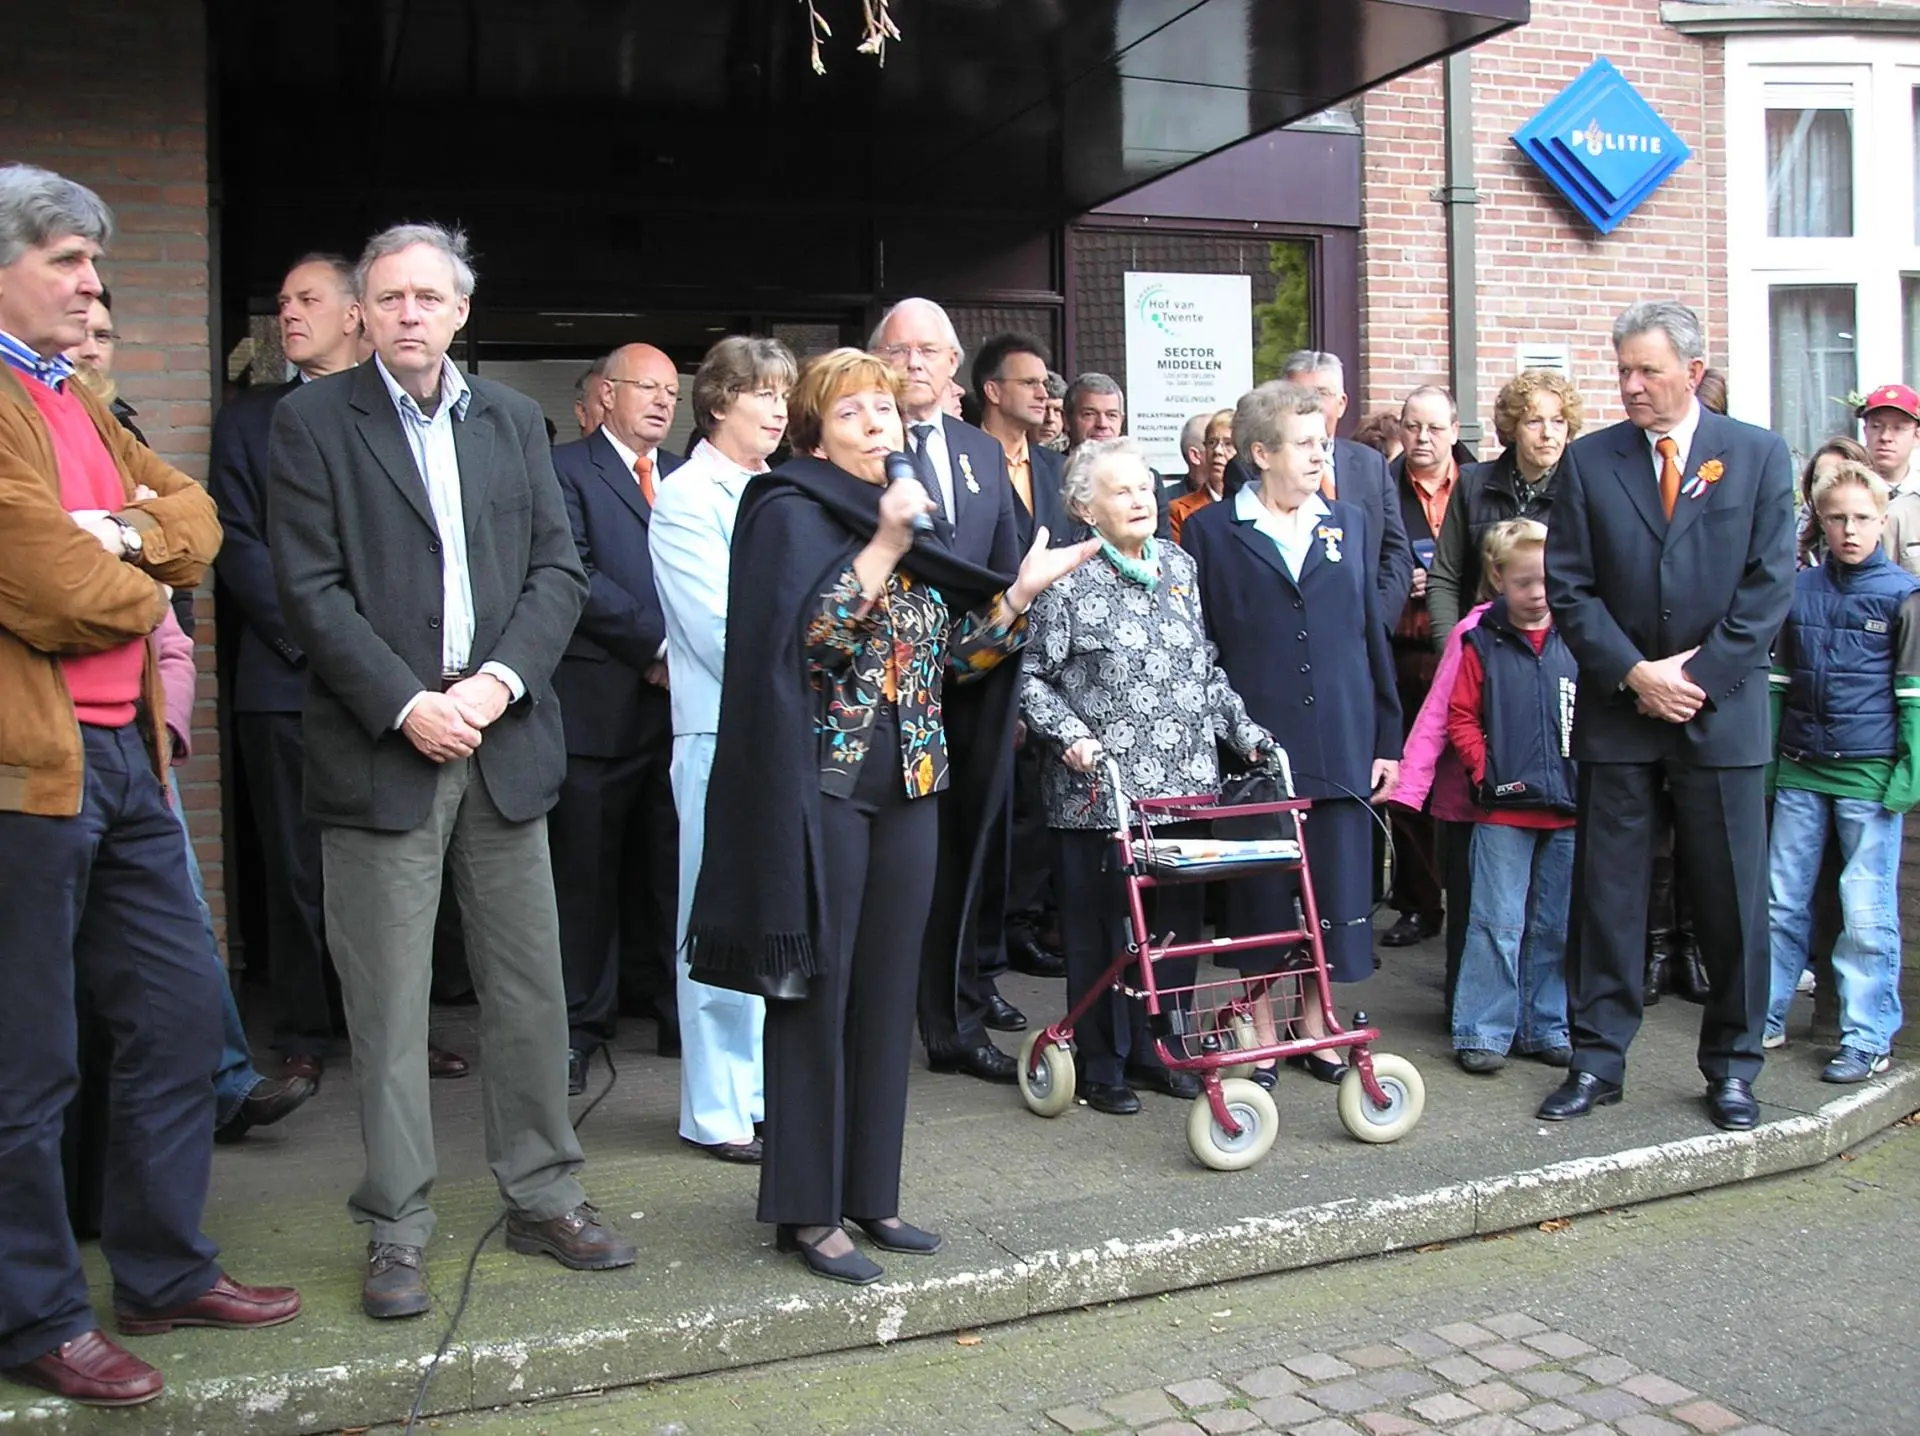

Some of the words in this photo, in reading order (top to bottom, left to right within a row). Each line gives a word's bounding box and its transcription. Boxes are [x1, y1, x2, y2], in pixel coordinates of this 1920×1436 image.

[1571, 127, 1661, 156] POLITIE
[1149, 300, 1170, 309] Hof
[1162, 312, 1204, 322] Twente
[1164, 347, 1215, 357] SECTOR
[1157, 360, 1222, 370] MIDDELEN
[1164, 395, 1216, 403] AFDELINGEN
